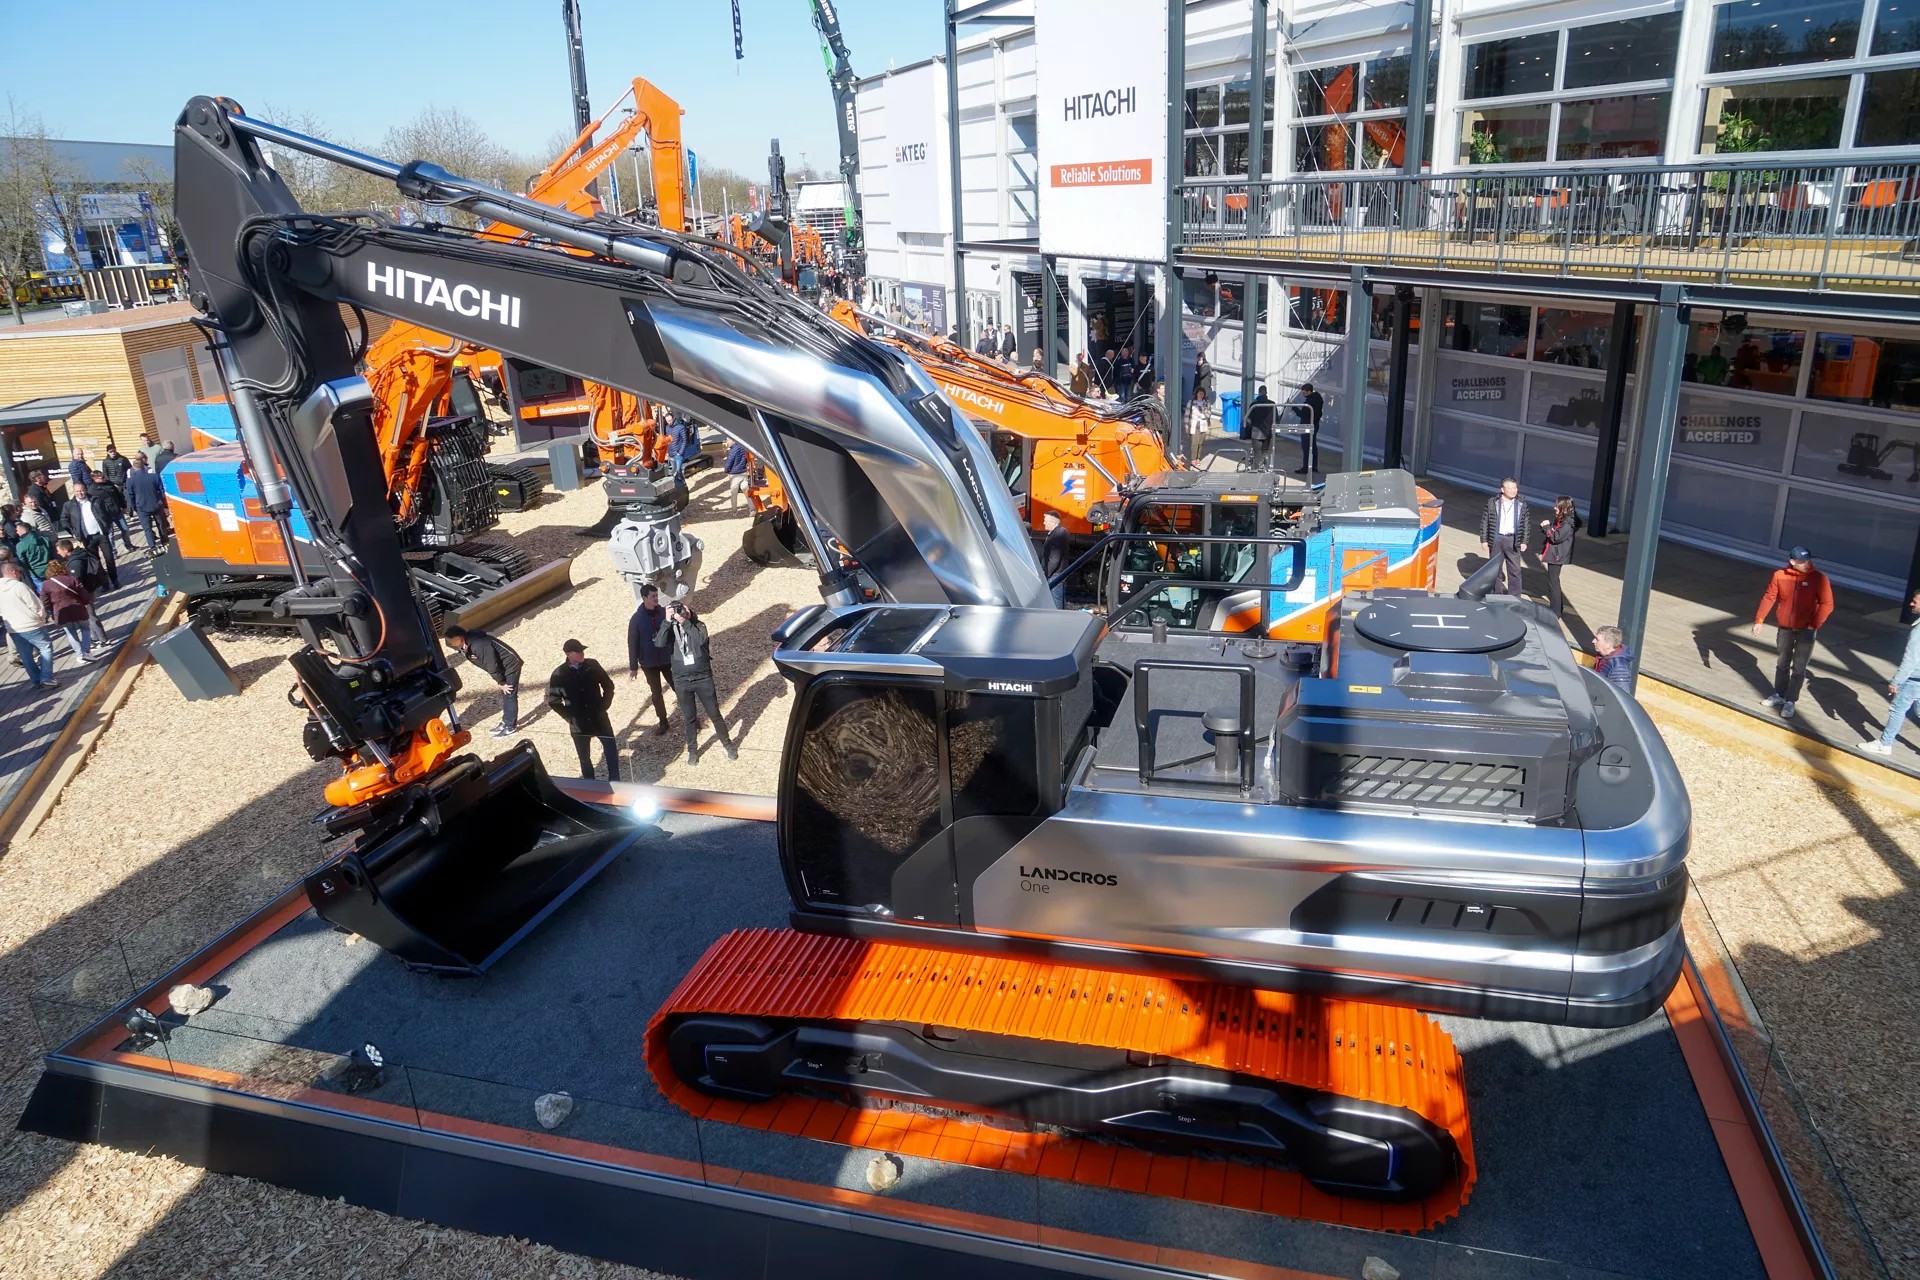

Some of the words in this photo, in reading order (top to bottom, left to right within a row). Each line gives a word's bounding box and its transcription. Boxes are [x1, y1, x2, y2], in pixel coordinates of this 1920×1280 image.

[1064, 86, 1136, 122] HITACHI
[585, 142, 620, 173] HITACHI
[901, 142, 927, 163] KTEG
[1060, 166, 1096, 184] Reliable
[1097, 164, 1142, 183] Solutions
[367, 261, 521, 329] HITACHI
[1452, 376, 1506, 388] CHALLENGES
[944, 382, 1005, 415] HITACHI
[1456, 389, 1502, 400] ACCEPTED
[540, 405, 577, 415] Sustainable
[1680, 415, 1762, 428] CHALLENGES
[1685, 431, 1754, 443] ACCEPTED
[962, 458, 991, 528] LANDCROS
[988, 681, 1033, 693] HITACHI
[1020, 866, 1118, 886] LANDCROS
[1020, 880, 1050, 894] One
[1177, 1115, 1192, 1124] Step
